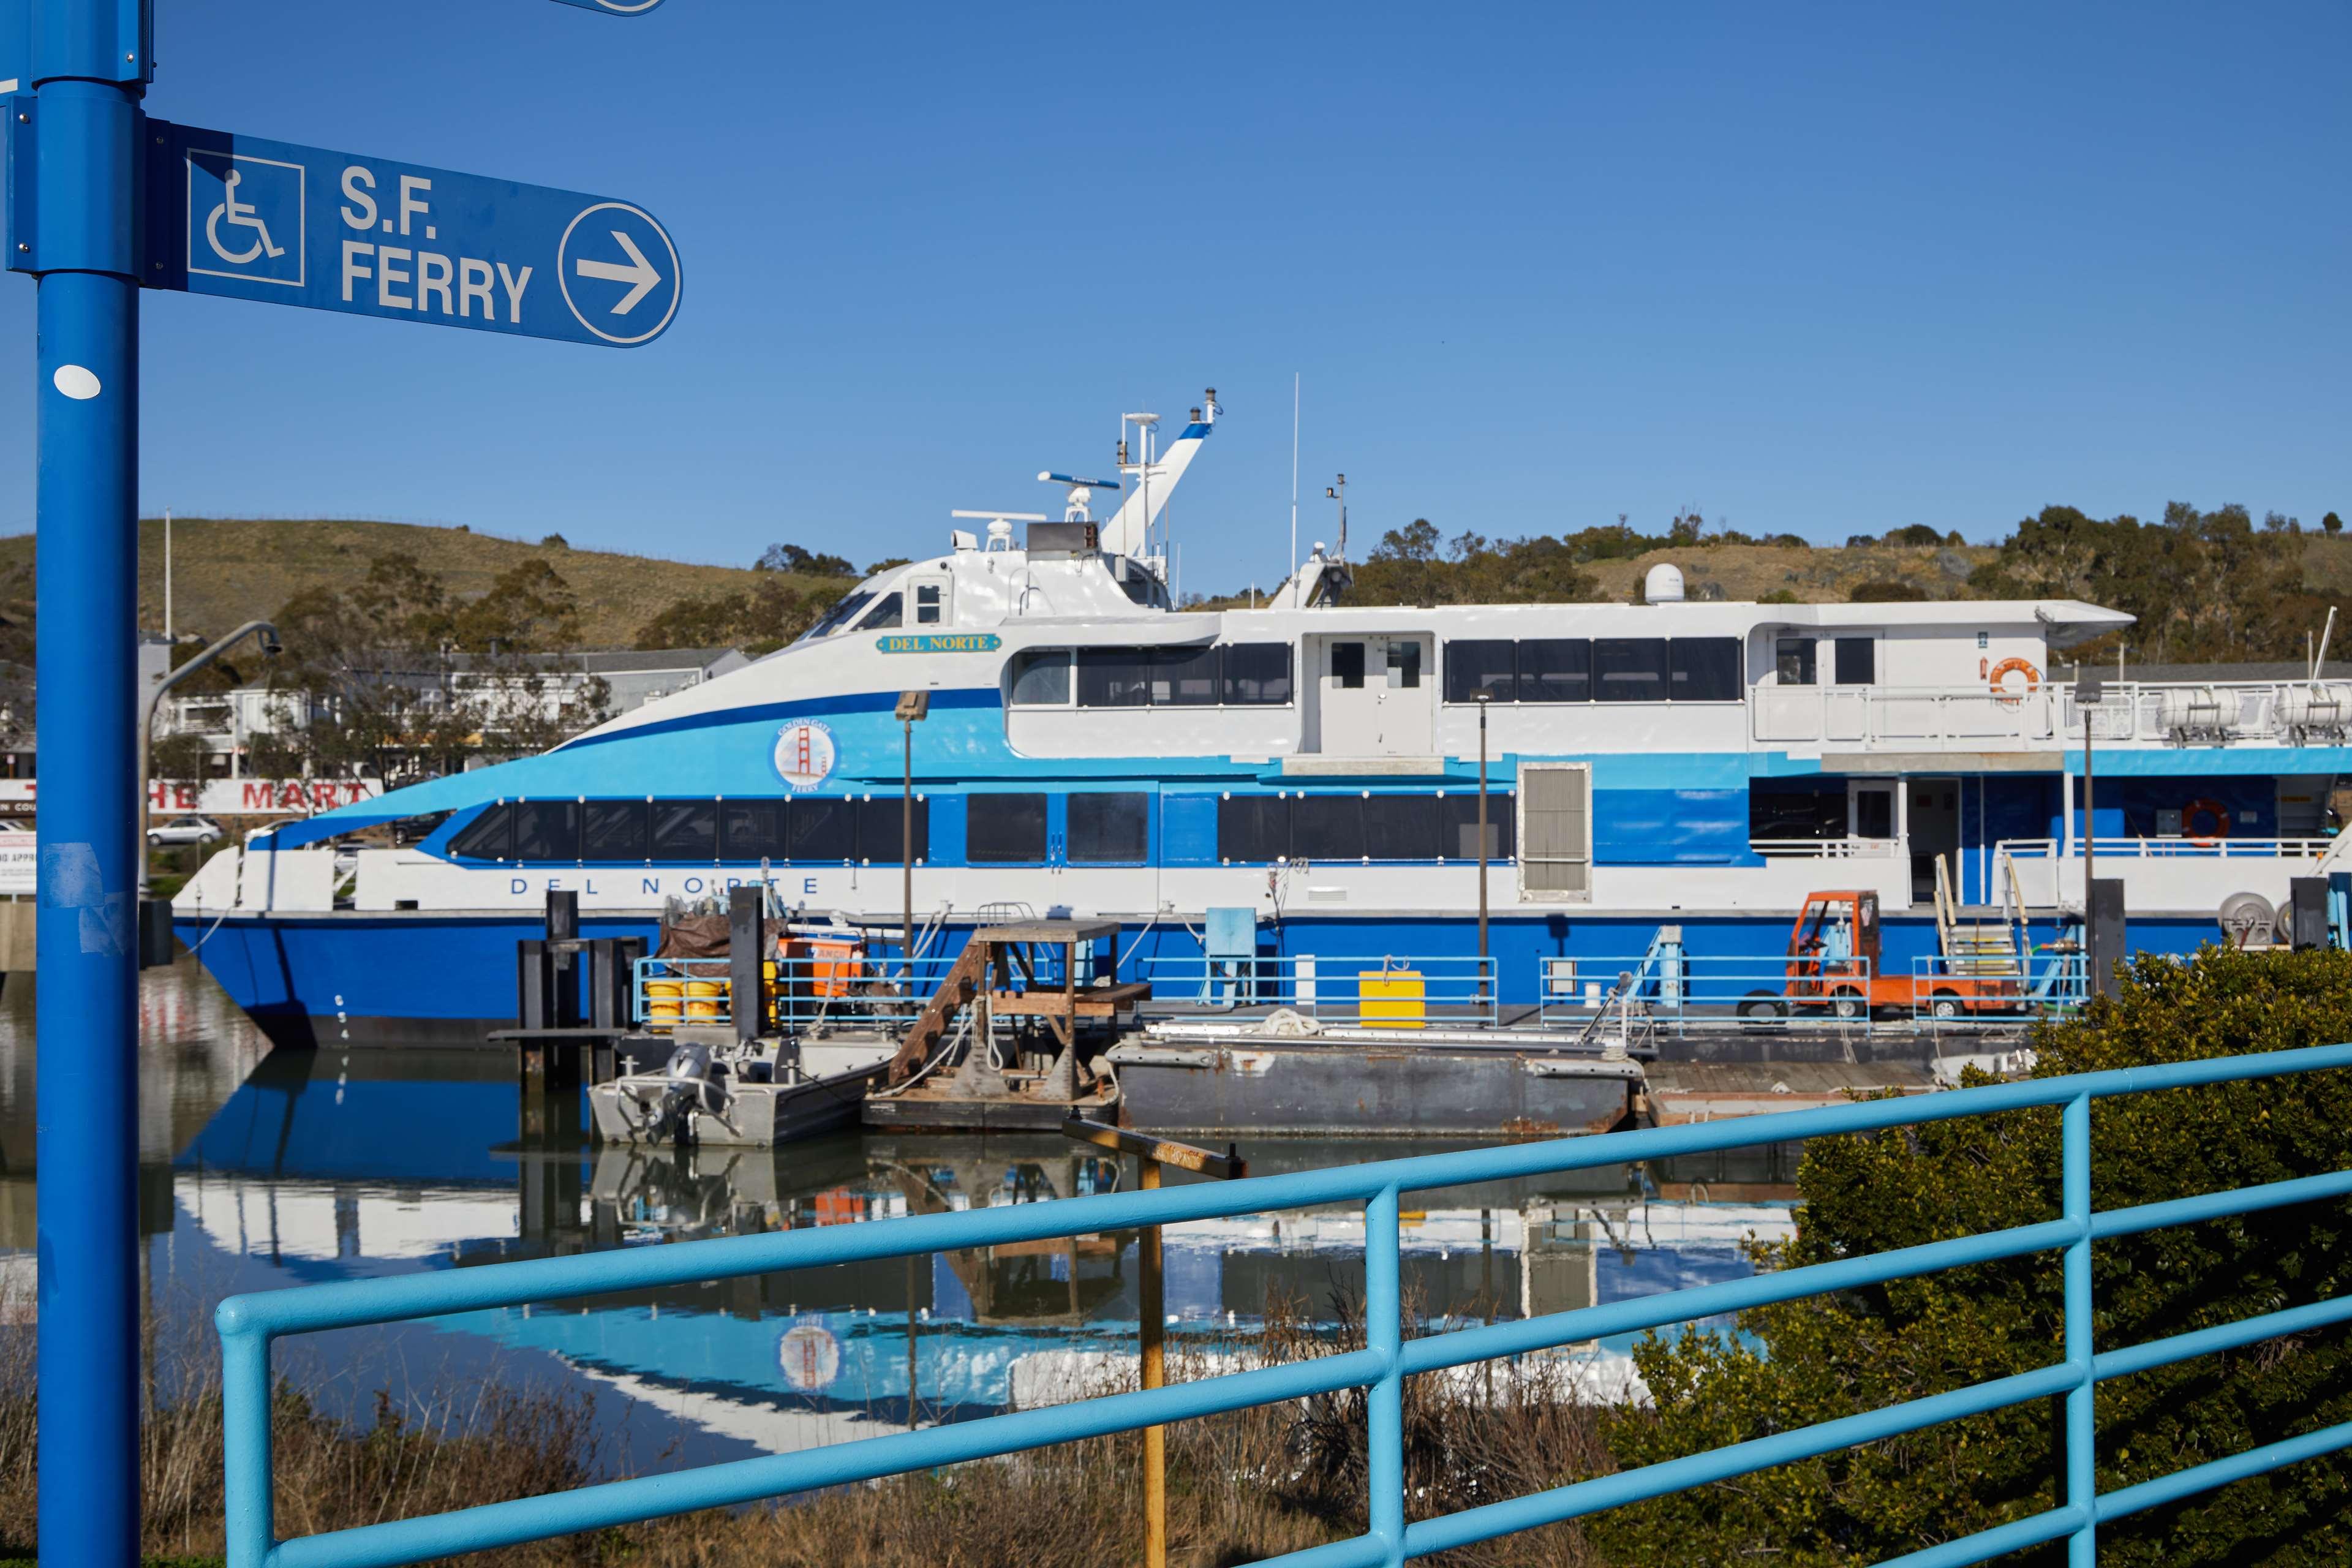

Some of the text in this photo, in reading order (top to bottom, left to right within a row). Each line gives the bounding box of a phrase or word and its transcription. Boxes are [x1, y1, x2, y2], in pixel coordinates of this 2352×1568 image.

[340, 165, 437, 239] S.F.
[342, 239, 533, 323] FERRY
[889, 635, 989, 650] DEL NORTE
[777, 718, 831, 736] GOLDEN GATE
[243, 783, 367, 809] MART
[511, 878, 598, 894] DEL
